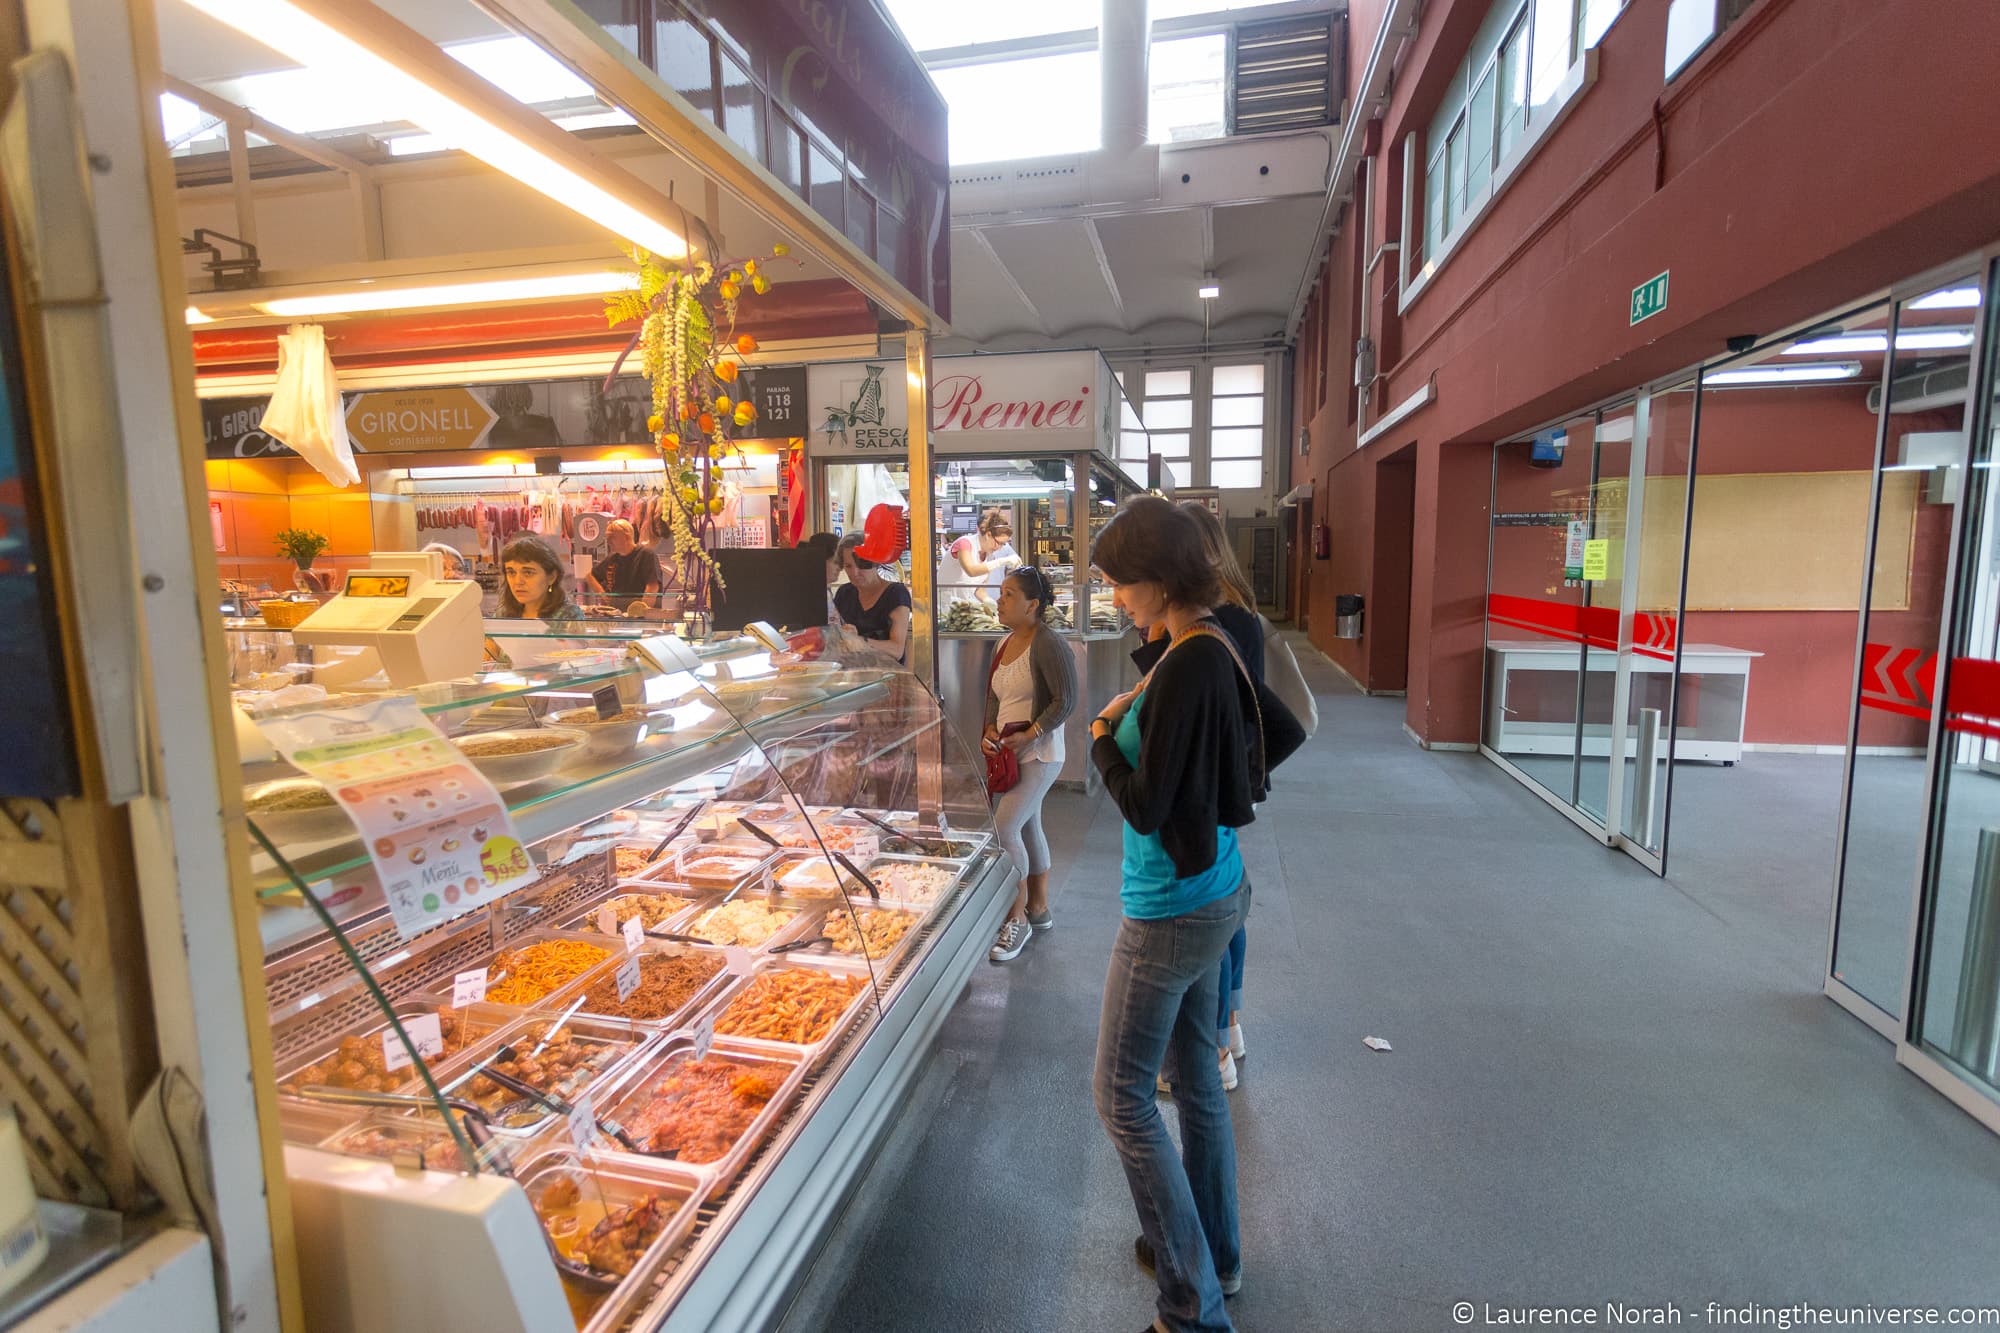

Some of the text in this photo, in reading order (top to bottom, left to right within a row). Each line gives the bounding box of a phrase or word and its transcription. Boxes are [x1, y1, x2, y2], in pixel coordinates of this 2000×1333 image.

[767, 394, 791, 407] 118
[931, 375, 1089, 431] Remei
[360, 407, 473, 434] GIRONELL
[767, 408, 790, 420] 121
